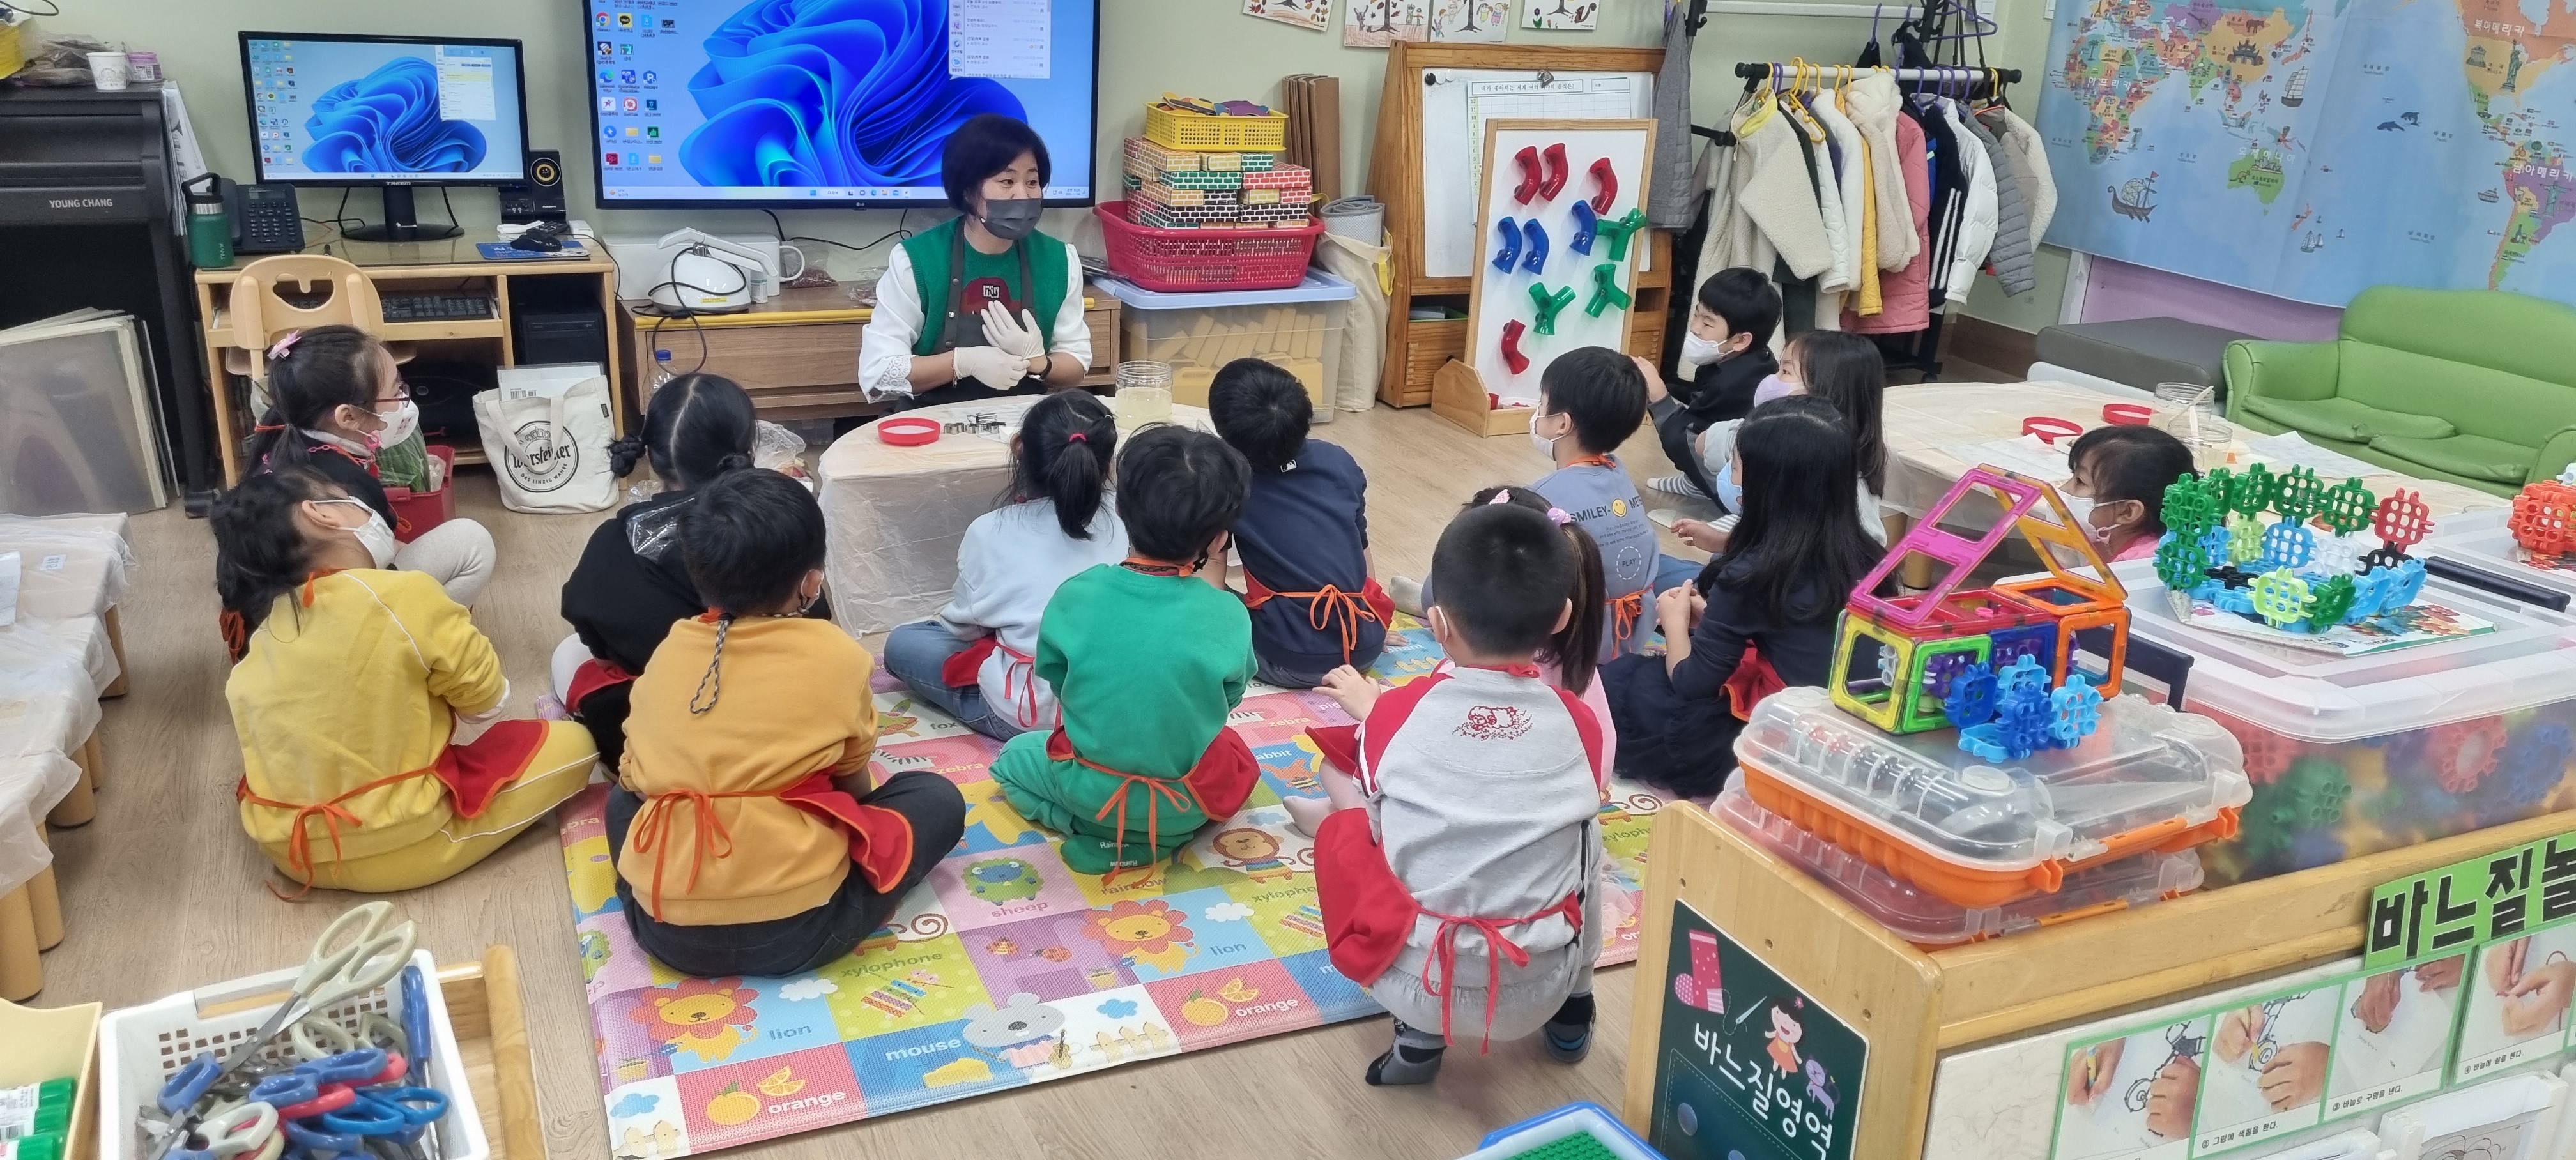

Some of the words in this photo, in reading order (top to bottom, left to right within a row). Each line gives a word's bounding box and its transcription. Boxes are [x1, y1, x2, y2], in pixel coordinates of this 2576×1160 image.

[2474, 19, 2524, 37] 북아메리카
[2089, 77, 2131, 90] 아프리카
[2238, 147, 2296, 164] 오세아니아
[2513, 162, 2573, 182] 남아메리카
[49, 199, 80, 208] YOUNG
[82, 199, 113, 207] CHANG
[511, 445, 571, 469] Wrsteier
[521, 473, 531, 482] DAS
[554, 463, 568, 479] WAHRE
[1622, 558, 1636, 567] PLAY
[1388, 644, 1424, 654] phant
[930, 722, 958, 730] fox
[1269, 717, 1310, 728] zebra
[1255, 749, 1292, 760] abbit
[937, 762, 984, 775] zebra
[1602, 827, 1650, 842] xyloph
[1101, 876, 1167, 895] rainow
[1252, 886, 1317, 903] xylopho
[991, 901, 1048, 919] sheep
[1210, 942, 1246, 956] lion
[841, 952, 942, 978] xylophone
[1236, 998, 1299, 1017] orange
[769, 1025, 812, 1041] lion
[885, 1037, 962, 1061] mouse
[2473, 1059, 2492, 1071] 바늘에
[2495, 1055, 2507, 1064] 실을
[768, 1092, 847, 1115] orange
[2343, 1096, 2363, 1108] 바늘로
[2366, 1090, 2385, 1101] 구멍을
[2212, 1133, 2234, 1145] 그림에
[2238, 1126, 2259, 1137] 색칠을
[2262, 1121, 2278, 1131] 한다.
